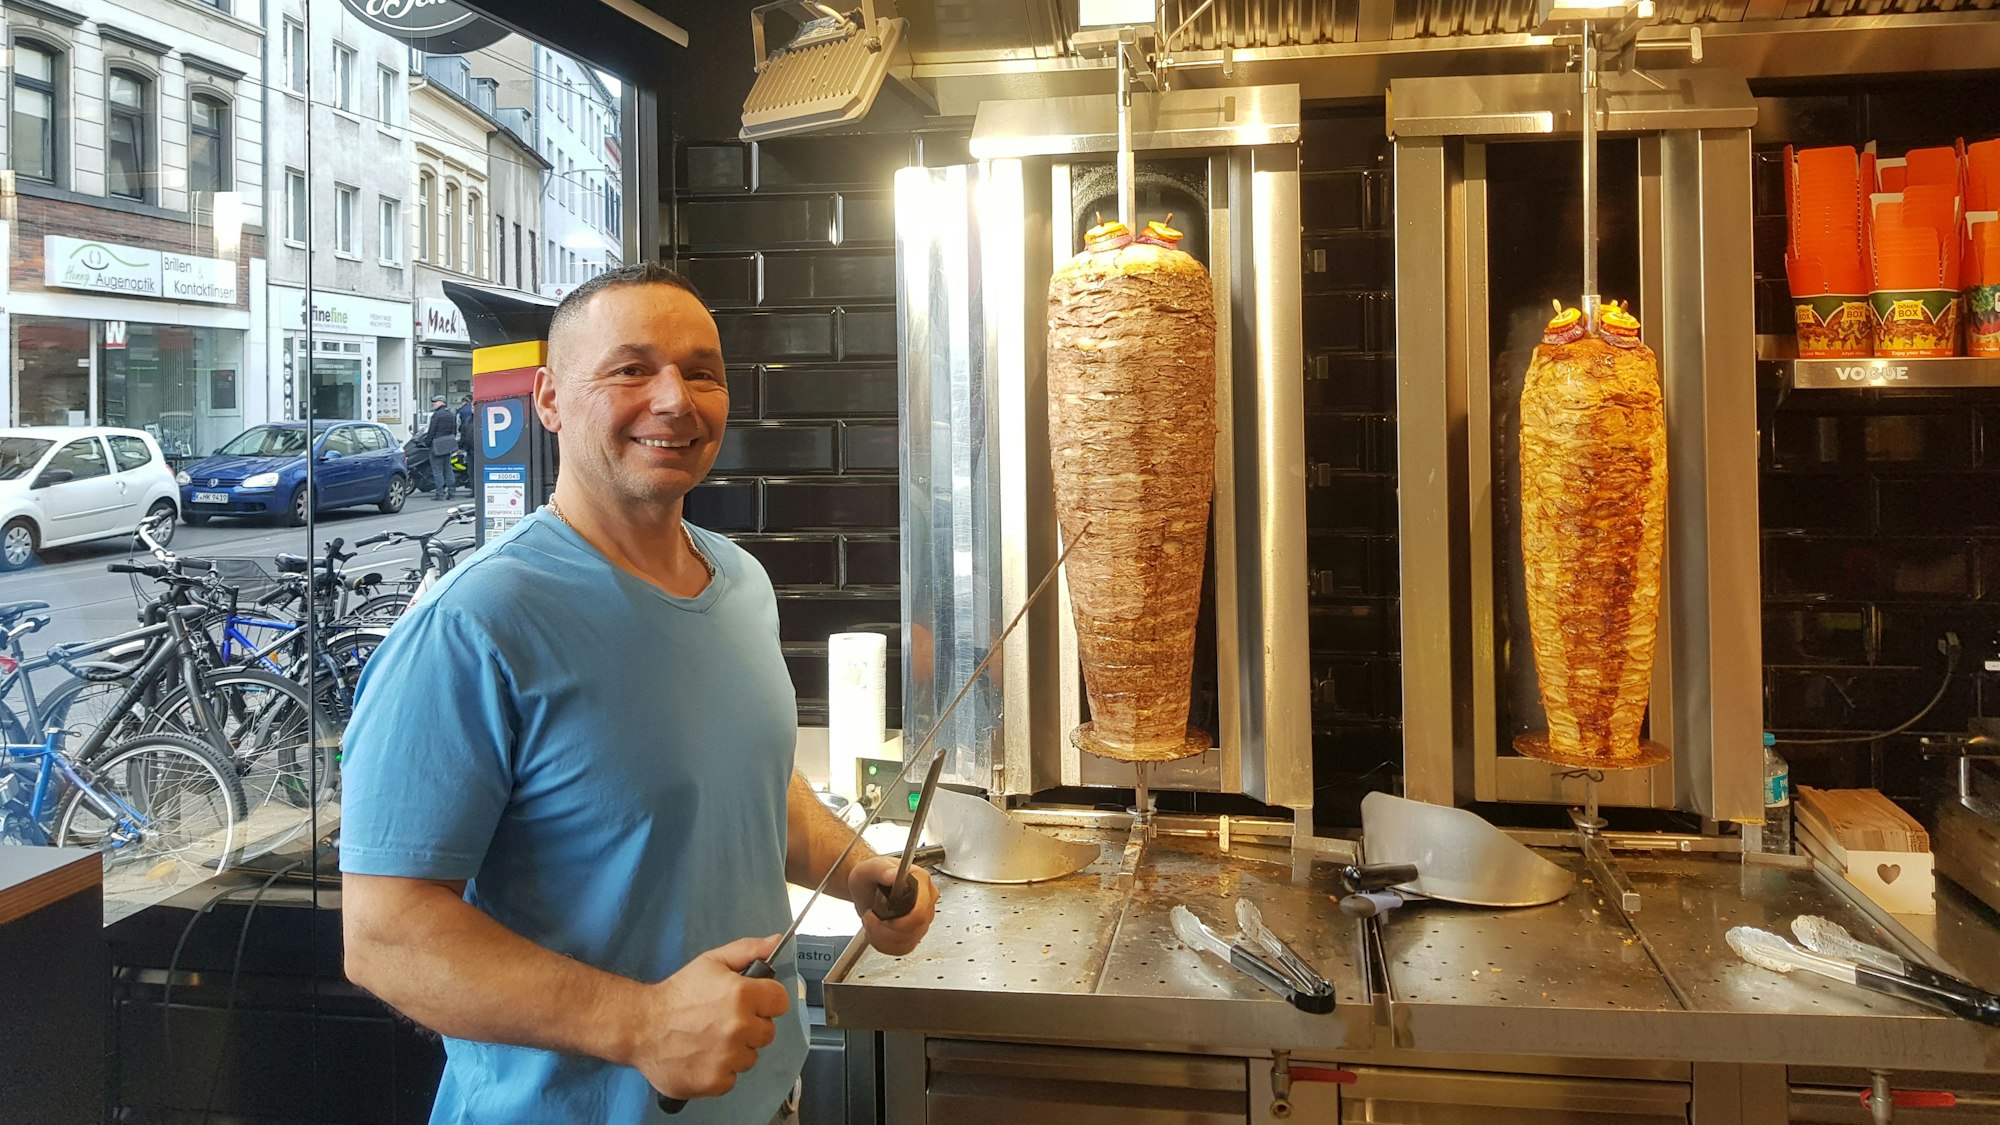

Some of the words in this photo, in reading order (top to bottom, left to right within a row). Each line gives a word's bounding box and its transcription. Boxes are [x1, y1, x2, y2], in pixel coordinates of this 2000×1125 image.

[164, 256, 192, 273] Brillen
[96, 272, 155, 292] Augenoptik
[174, 280, 235, 300] Kontaktlinsen
[428, 306, 458, 335] Mack
[1846, 310, 1864, 318] BOX
[1898, 309, 1919, 318] BOX
[1835, 366, 1909, 381] VOGUE
[487, 406, 511, 447] P
[798, 951, 831, 962] astro
